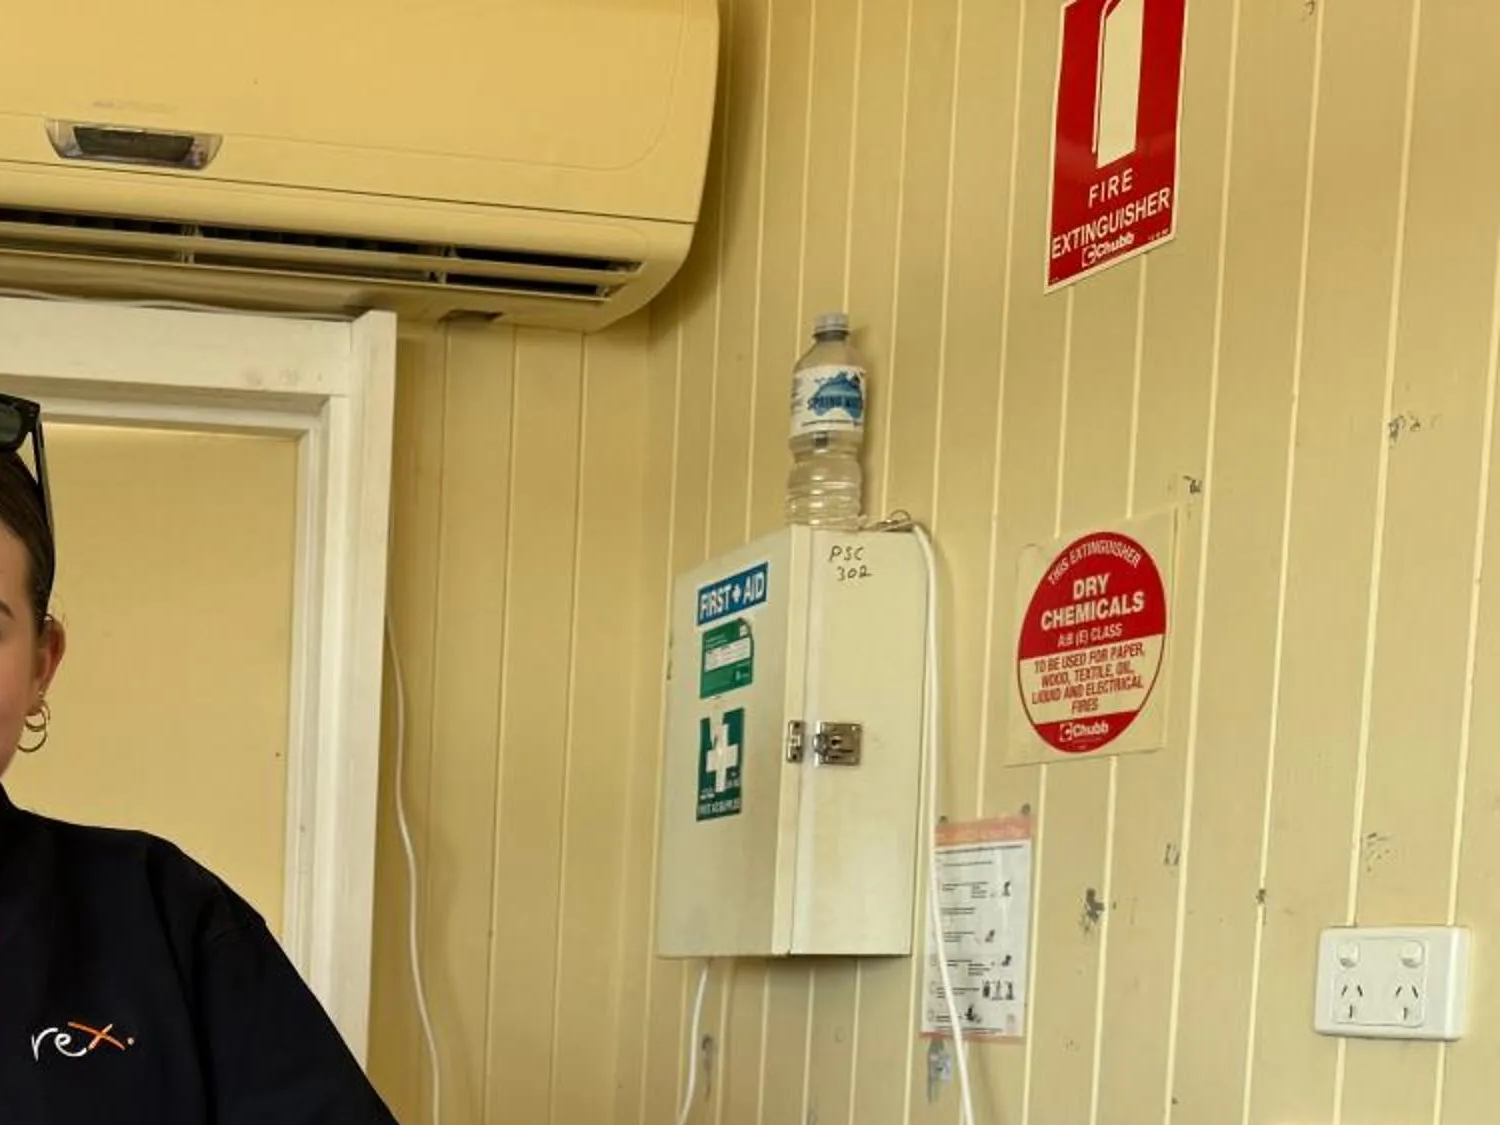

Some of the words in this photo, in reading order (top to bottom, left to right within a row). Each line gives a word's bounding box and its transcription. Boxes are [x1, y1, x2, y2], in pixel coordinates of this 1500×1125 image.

[1088, 168, 1133, 208] FIRE
[1052, 187, 1170, 259] EXTINGUISHER
[1095, 232, 1134, 258] Chubb
[828, 545, 864, 562] PSC
[837, 565, 873, 581] 302
[700, 584, 732, 619] FIRST
[743, 572, 766, 606] AID
[1073, 572, 1111, 600] DRY
[1041, 591, 1145, 631] CHEMICALS
[1090, 622, 1123, 641] CLASS
[1035, 660, 1046, 673] TO
[1047, 658, 1061, 671] BE
[1062, 652, 1087, 668] USED
[1089, 648, 1109, 664] FOR
[1064, 684, 1084, 698] AND
[1086, 675, 1144, 696] ELECTRICAL
[1071, 698, 1099, 714] FIRES
[1071, 720, 1109, 736] Chubb
